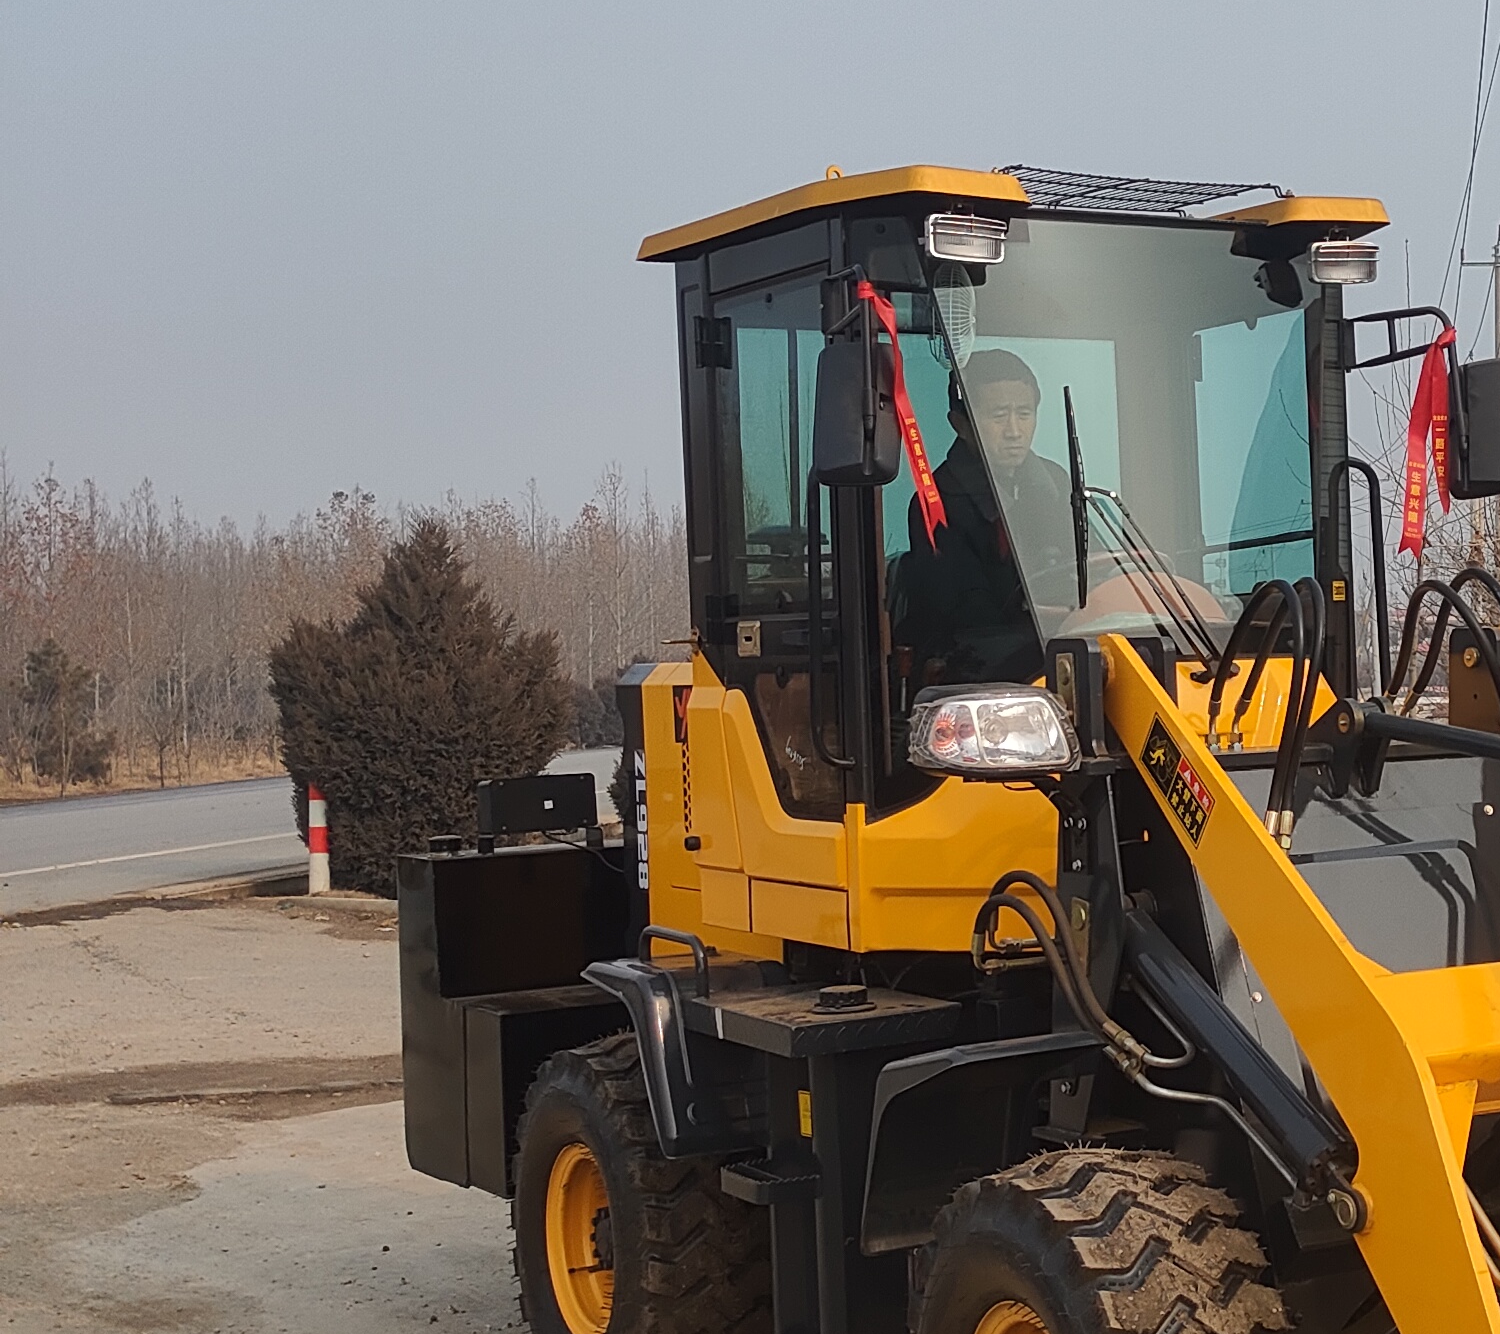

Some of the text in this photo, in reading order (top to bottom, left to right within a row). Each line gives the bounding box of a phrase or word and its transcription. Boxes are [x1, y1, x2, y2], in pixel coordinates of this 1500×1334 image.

[1407, 471, 1422, 524] 生意兴隆
[633, 750, 649, 890] ZL928
